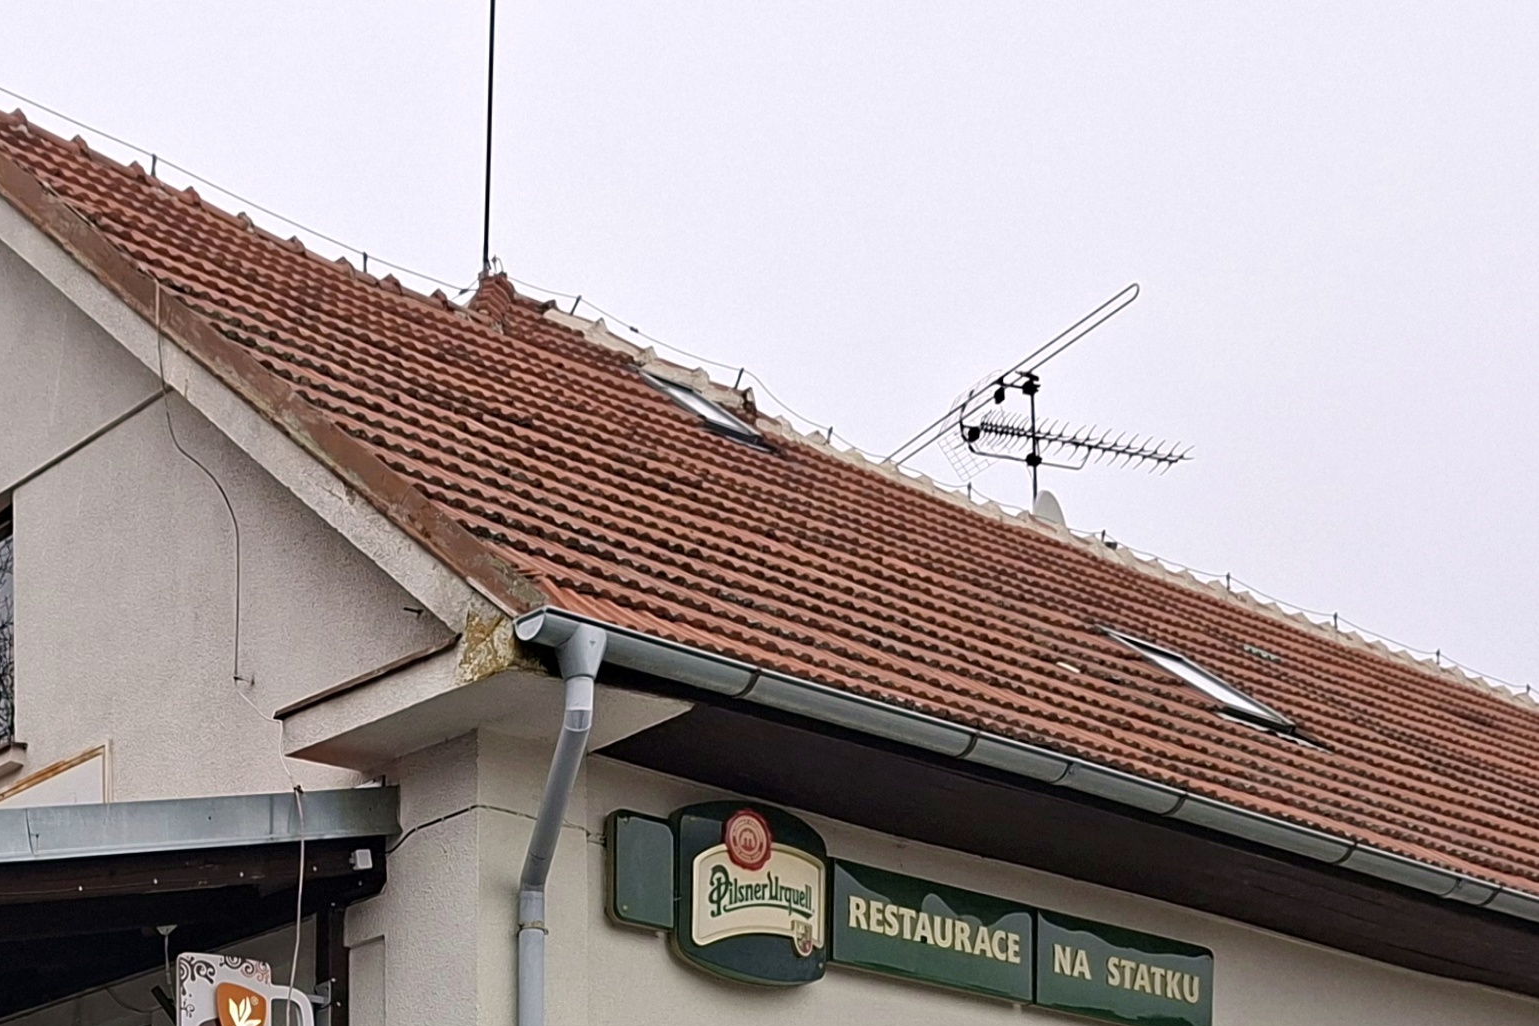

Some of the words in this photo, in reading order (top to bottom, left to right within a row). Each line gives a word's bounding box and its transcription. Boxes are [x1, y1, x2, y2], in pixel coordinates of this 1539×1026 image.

[708, 864, 768, 918] Pilsner
[767, 871, 812, 917] Urquell
[847, 895, 1022, 964] RESTAURACE
[1052, 943, 1092, 981] NA
[1107, 958, 1200, 1004] STATKU
